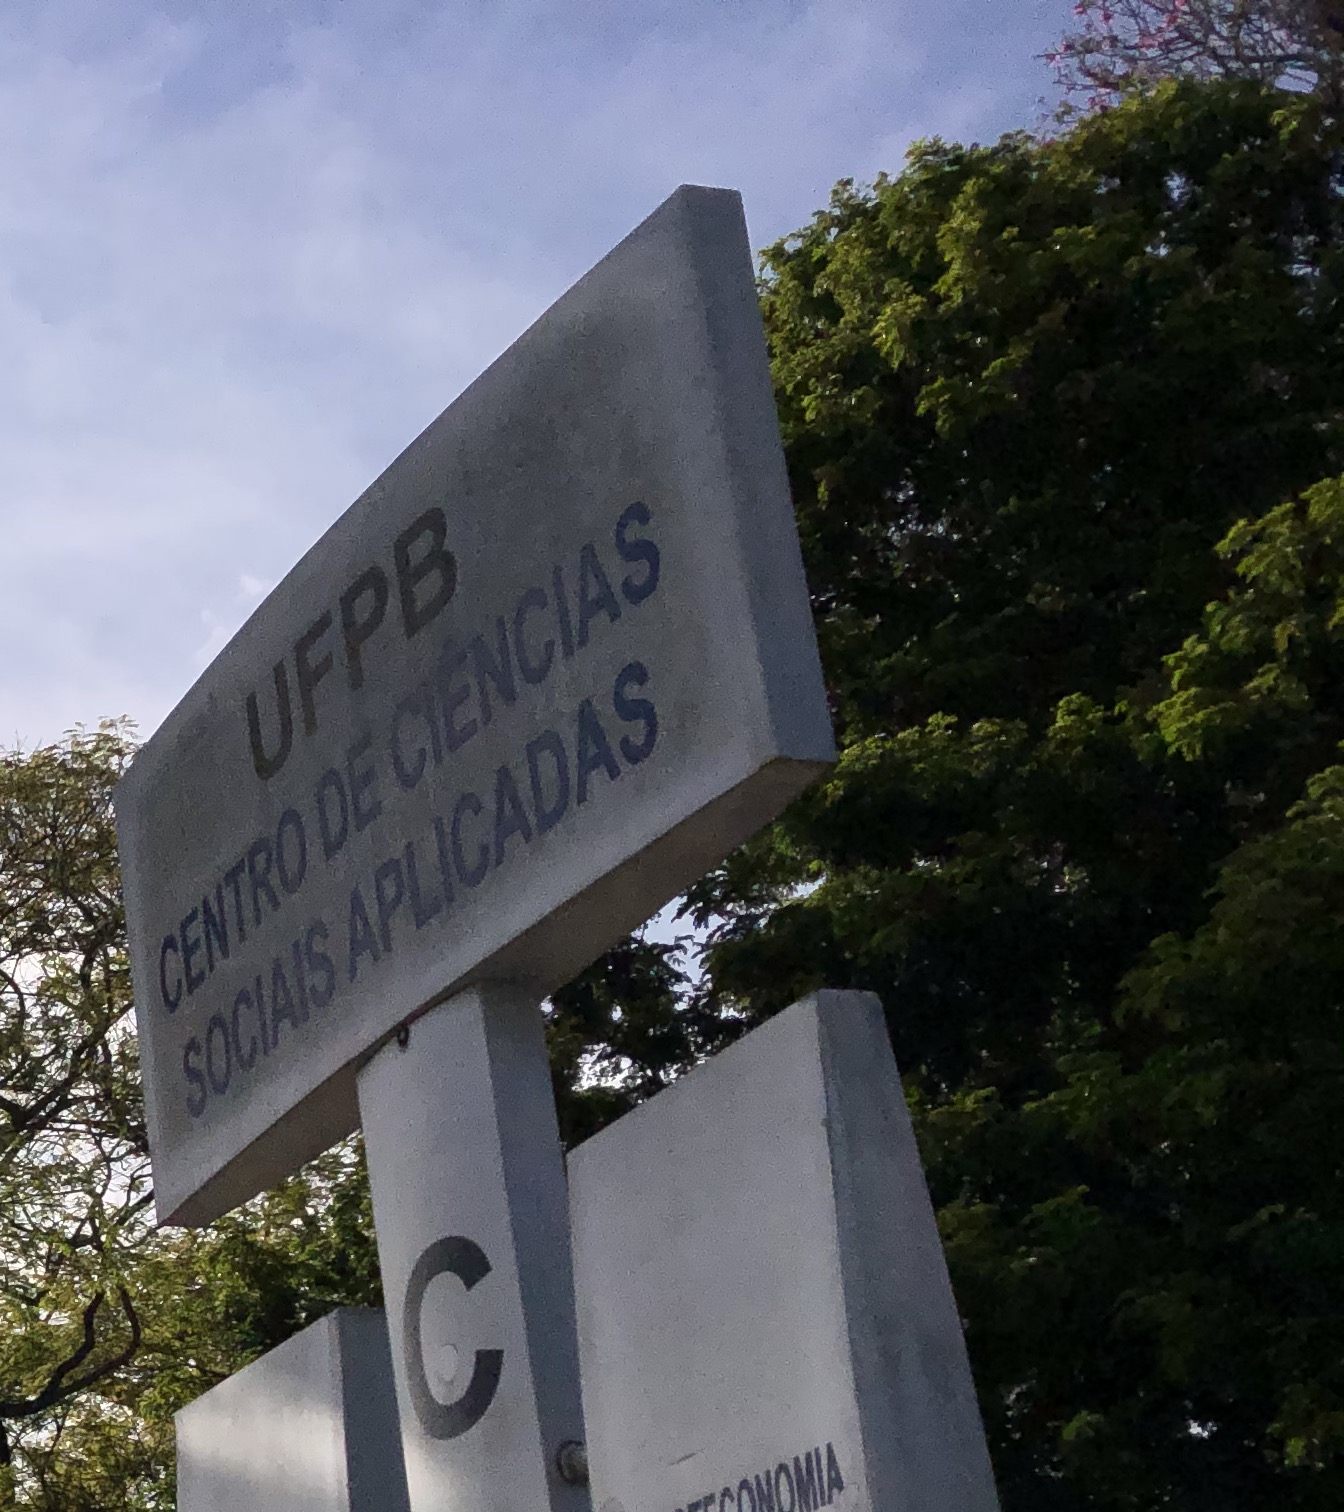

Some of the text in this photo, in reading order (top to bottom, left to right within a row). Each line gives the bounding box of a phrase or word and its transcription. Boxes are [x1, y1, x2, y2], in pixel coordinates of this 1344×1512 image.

[246, 506, 457, 781] UFPB
[160, 808, 308, 1014] CENTRO
[316, 733, 382, 862] DE
[183, 661, 659, 1119] SOCIAIS APLICADAS
